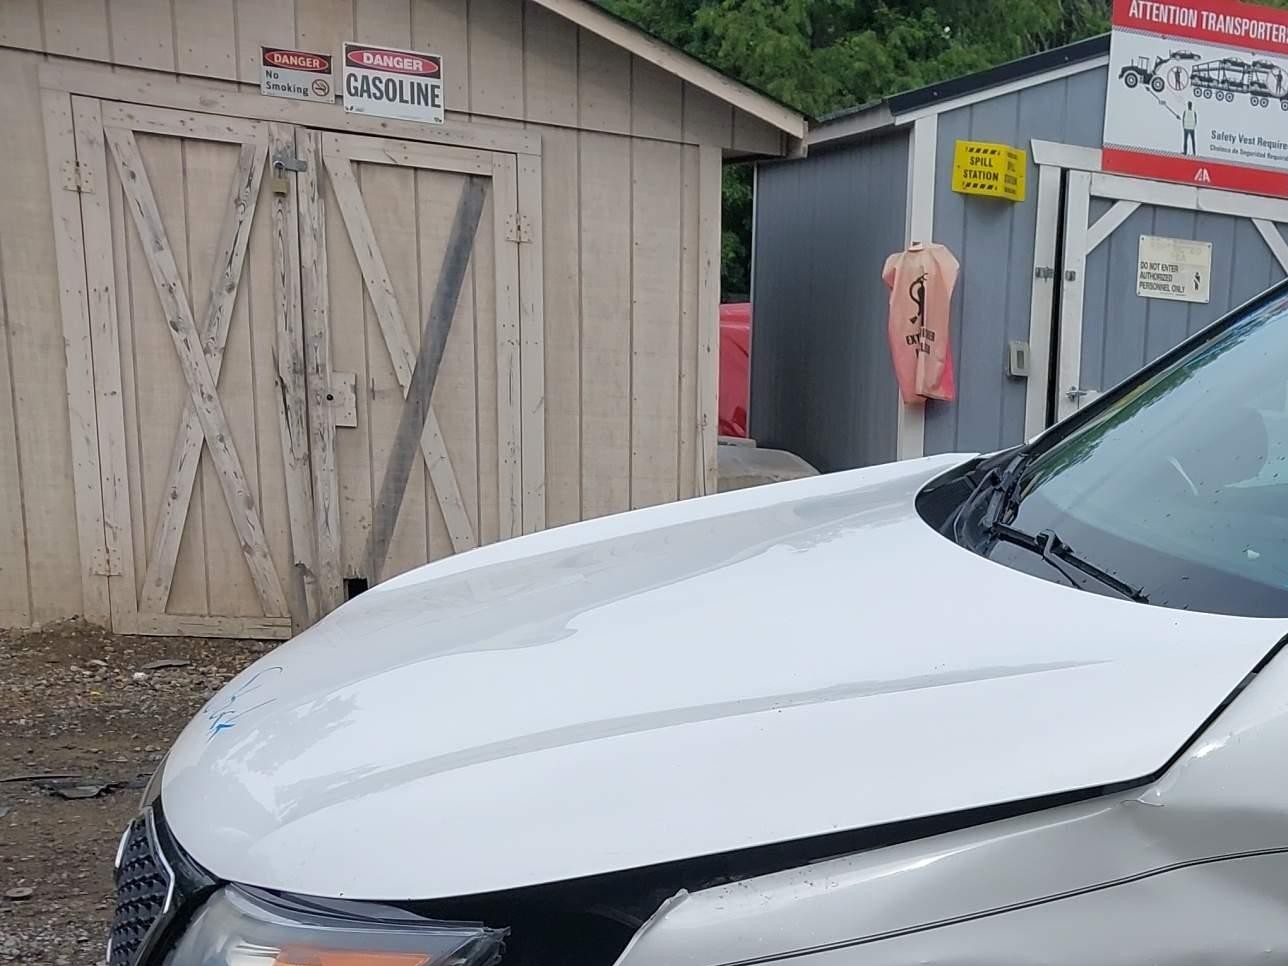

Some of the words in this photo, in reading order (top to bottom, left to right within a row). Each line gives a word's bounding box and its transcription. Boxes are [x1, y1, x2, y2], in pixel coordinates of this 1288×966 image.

[1129, 0, 1198, 28] ATTENTION
[273, 52, 320, 69] DANGER
[363, 52, 424, 72] DANGER
[265, 69, 279, 81] No
[265, 80, 309, 97] Smoking
[346, 73, 442, 108] GASOLINE
[1211, 129, 1237, 144] Safety
[1238, 132, 1256, 145] Vest
[970, 156, 994, 167] SPILL
[963, 169, 999, 182] STATION
[1140, 261, 1149, 270] DO
[1149, 262, 1160, 271] NOT
[1161, 263, 1179, 273] ENTER
[1140, 271, 1173, 282] AUTHORIZED
[1139, 281, 1170, 292] PERSONNEL
[1171, 284, 1185, 293] ONLY
